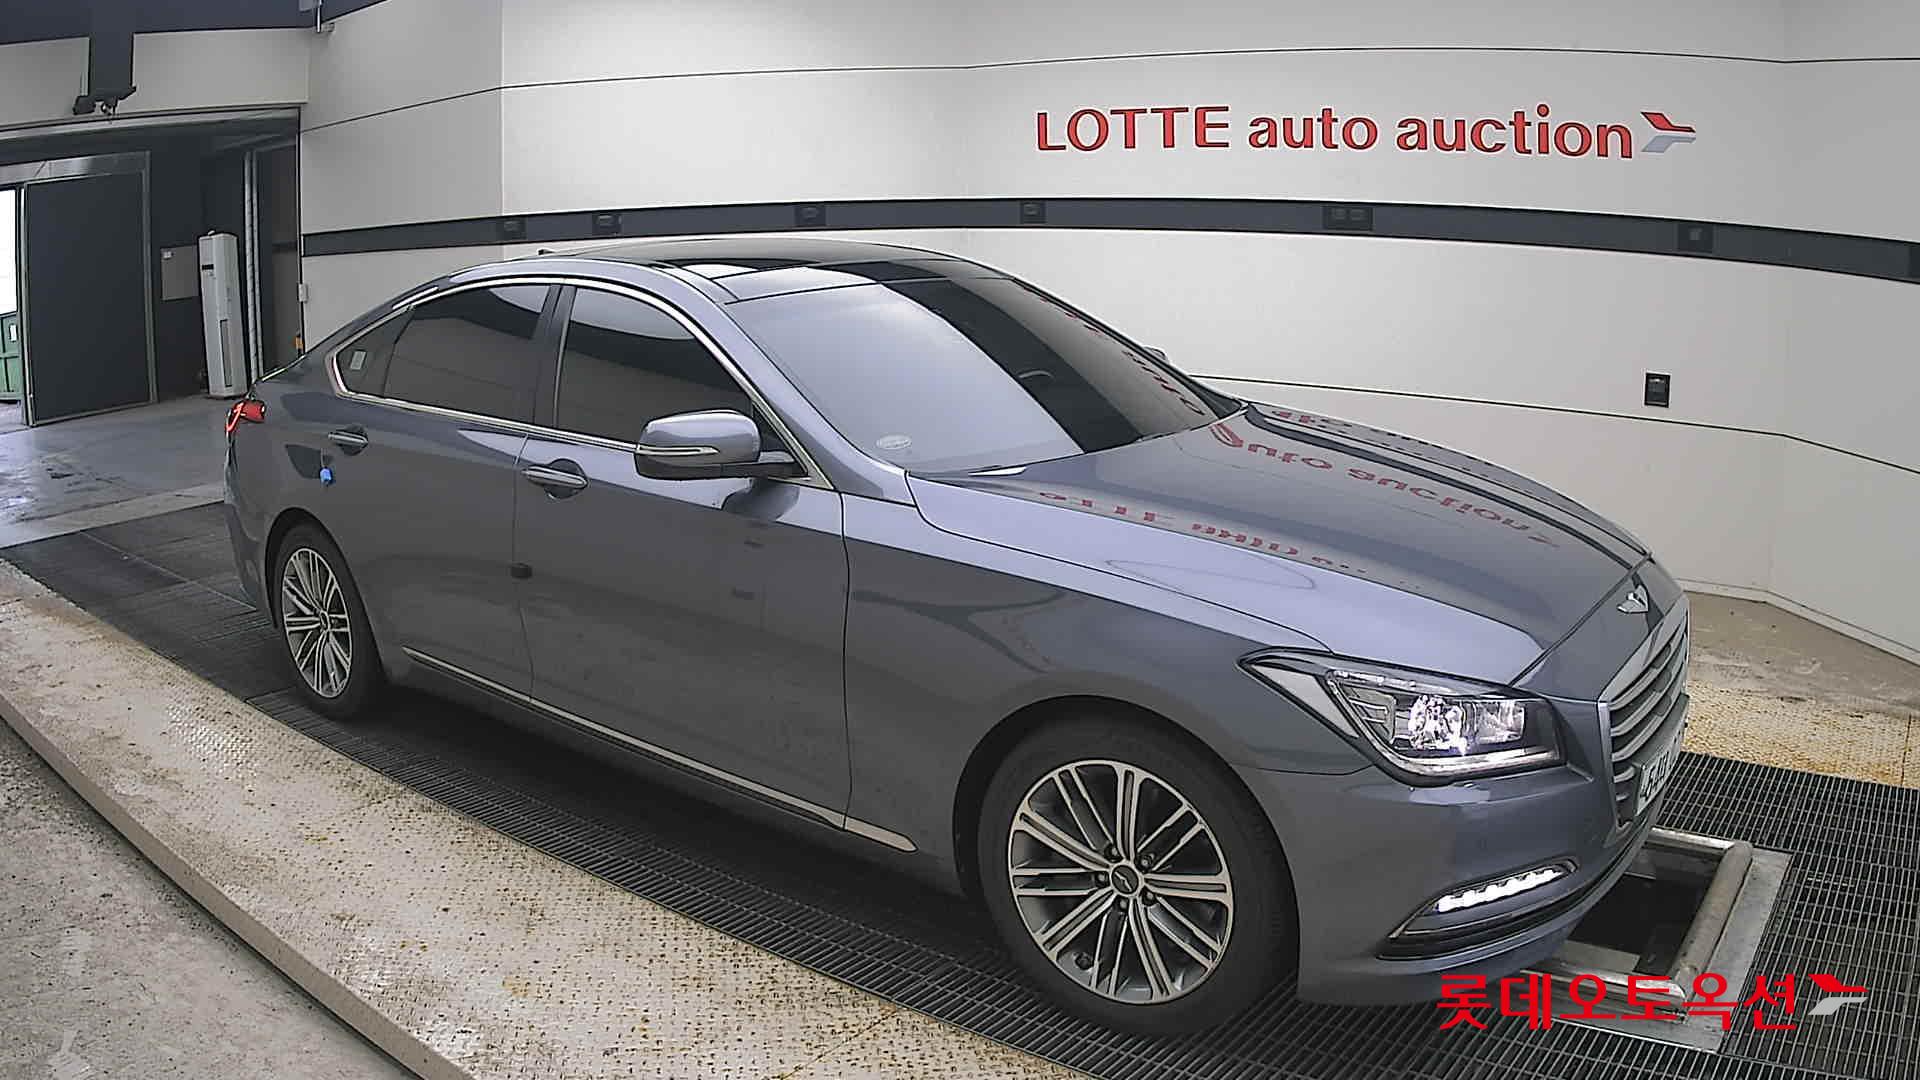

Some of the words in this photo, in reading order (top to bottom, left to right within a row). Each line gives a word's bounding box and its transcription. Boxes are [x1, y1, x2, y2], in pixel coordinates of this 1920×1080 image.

[1037, 107, 1228, 151] LOTTE
[1248, 107, 1378, 150] auto
[1397, 104, 1633, 158] auction
